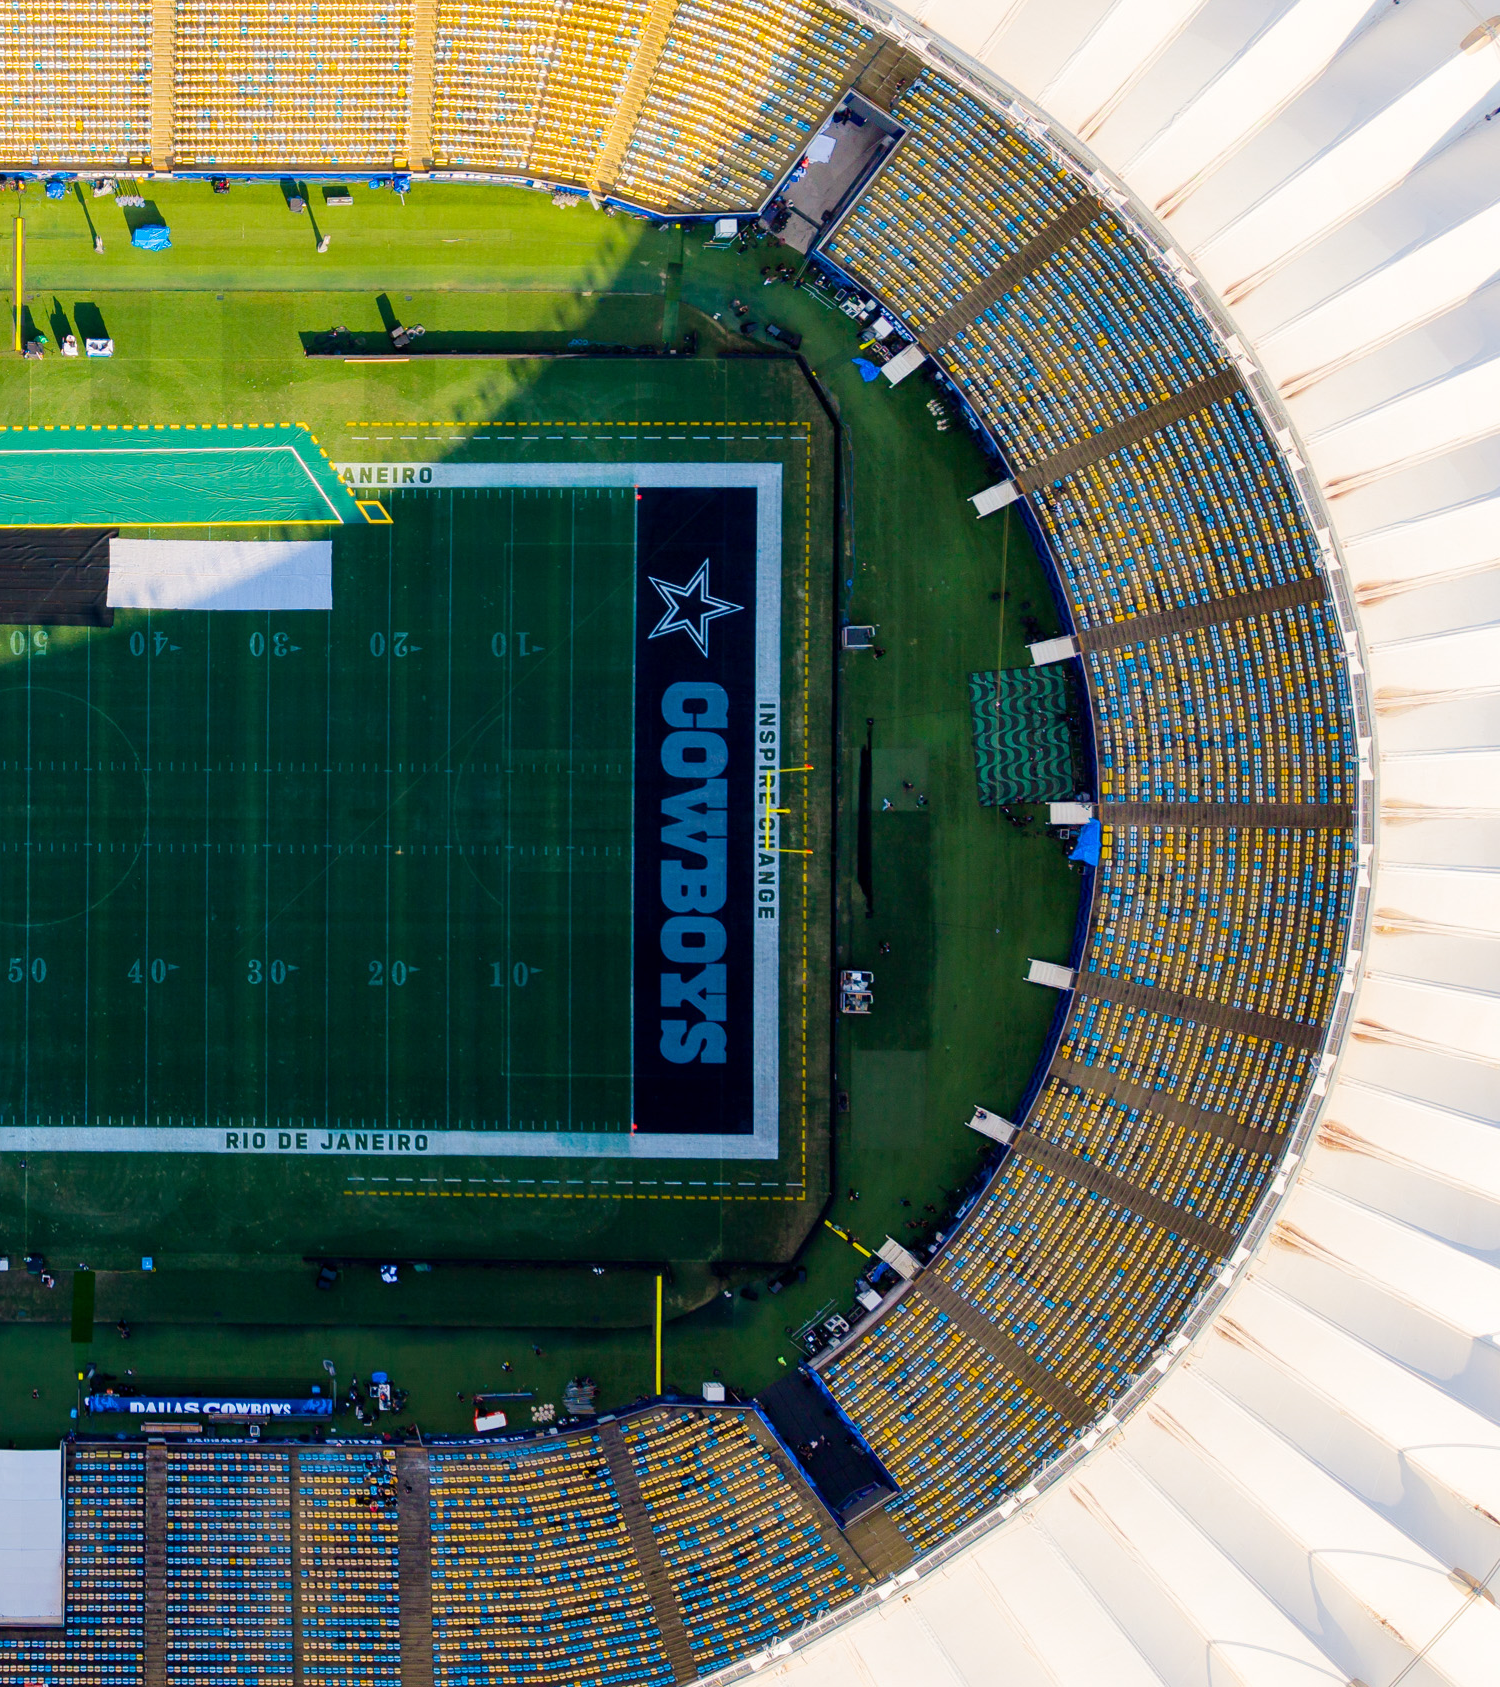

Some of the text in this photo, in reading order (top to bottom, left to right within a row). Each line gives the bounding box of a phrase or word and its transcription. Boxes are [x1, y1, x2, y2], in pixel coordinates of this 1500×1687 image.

[343, 466, 432, 484] ANEIRO
[9, 630, 49, 656] 50
[129, 631, 168, 656] 40
[249, 631, 289, 657] 30
[369, 632, 408, 657] 20
[490, 632, 530, 658] 10
[757, 702, 776, 919] INSPIRE CHANGE
[659, 681, 729, 1064] COWBOYS
[8, 957, 48, 983] 50
[127, 958, 167, 984] 40
[247, 959, 286, 985] 30
[368, 960, 408, 986] 20
[489, 961, 529, 987] 10
[225, 1132, 428, 1152] RIO DE JANEIRO
[130, 1402, 291, 1415] DALLAS COWBOYS
